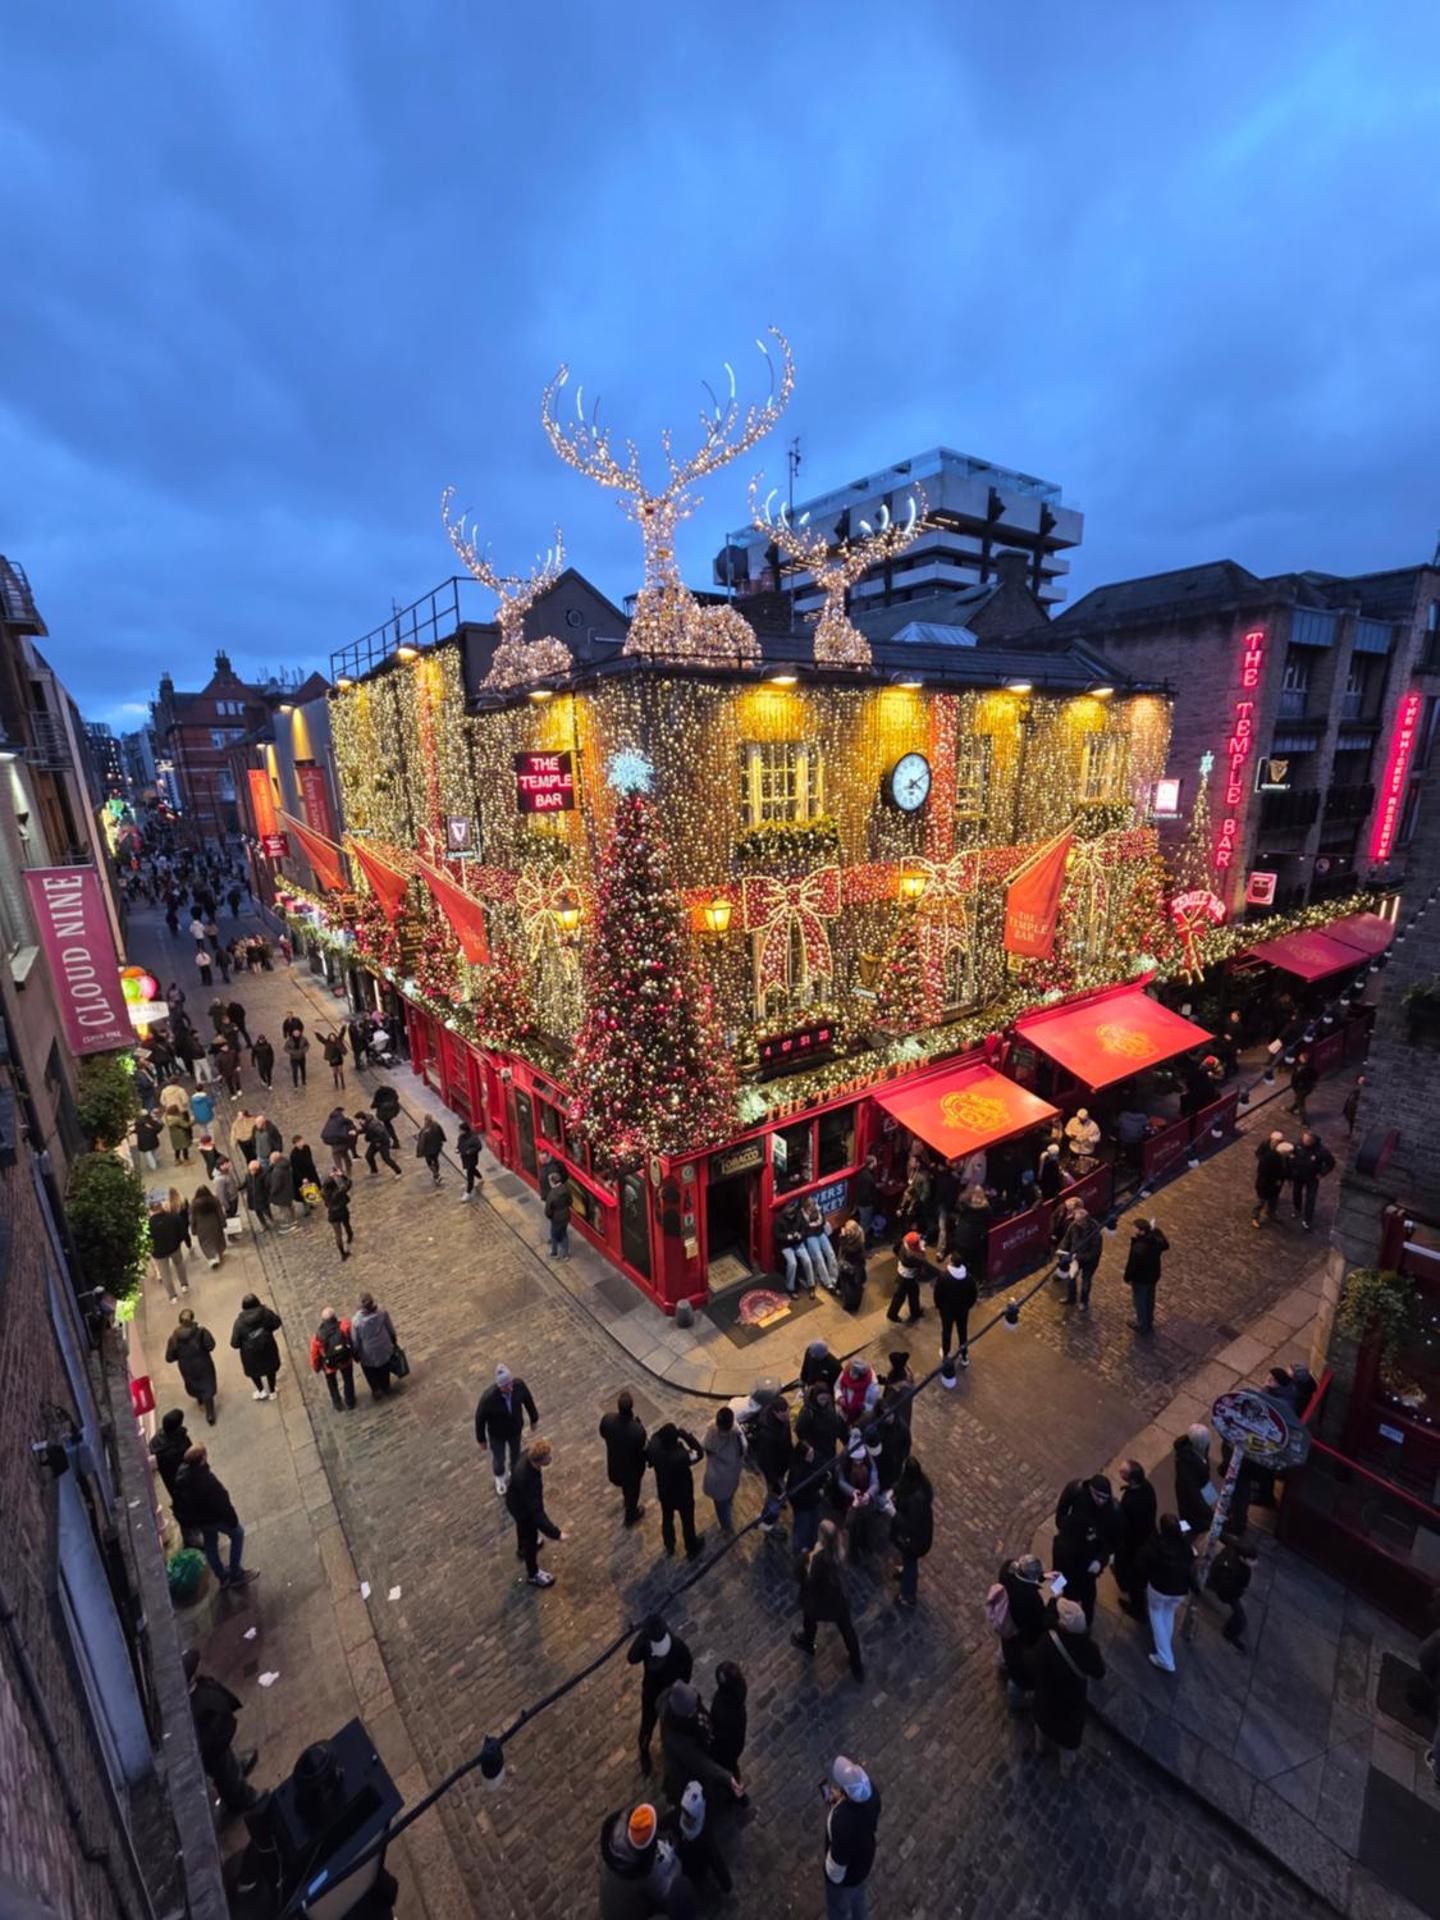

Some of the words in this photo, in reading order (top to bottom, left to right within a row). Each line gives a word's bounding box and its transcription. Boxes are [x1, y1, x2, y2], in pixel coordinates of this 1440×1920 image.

[1243, 632, 1264, 686] THE
[1404, 697, 1418, 726] THE
[519, 773, 572, 789] TEMPLE
[530, 757, 559, 771] THE
[1226, 702, 1254, 804] TEMPLE
[1391, 731, 1412, 792] WHISKEY
[535, 792, 563, 808] BAR
[1378, 797, 1398, 857] RESERVE
[1216, 819, 1235, 867] BAR
[42, 875, 86, 939] NINE
[61, 946, 116, 1027] CLOUD
[765, 1098, 807, 1123] THE
[813, 1068, 889, 1106] TEMPLE
[896, 1057, 931, 1077] BAR
